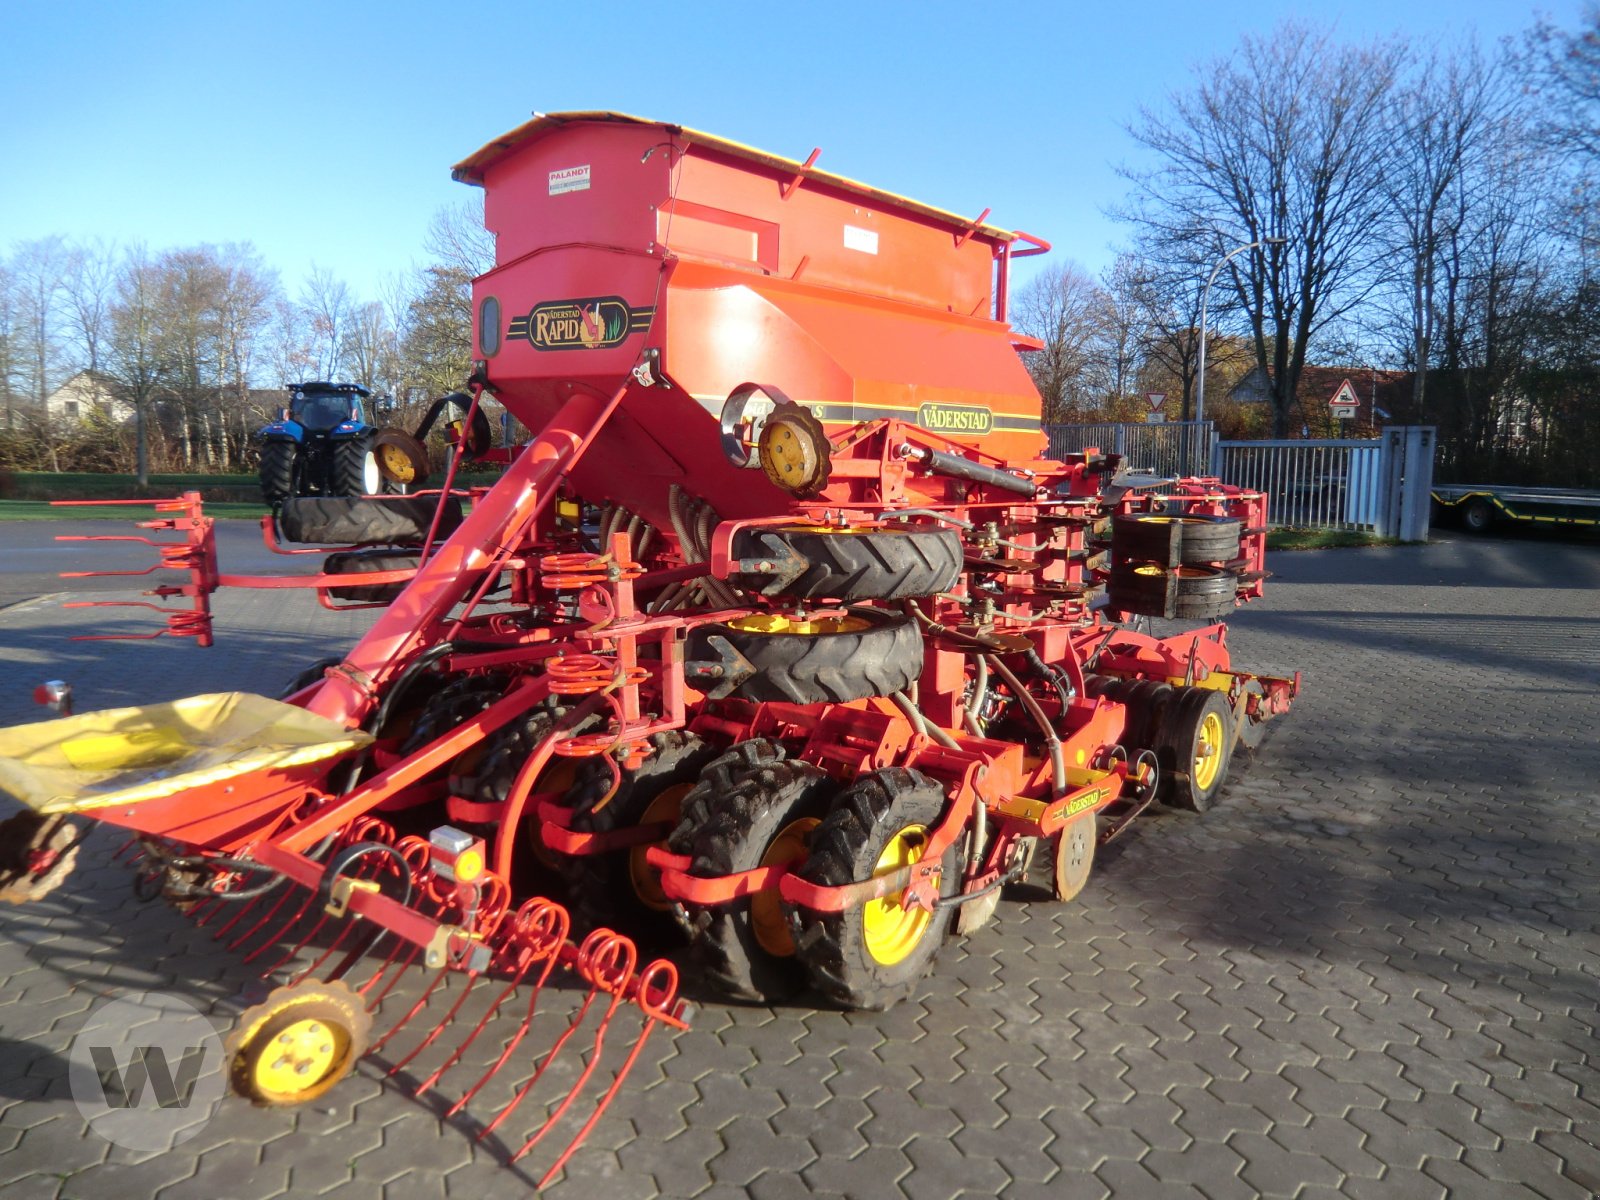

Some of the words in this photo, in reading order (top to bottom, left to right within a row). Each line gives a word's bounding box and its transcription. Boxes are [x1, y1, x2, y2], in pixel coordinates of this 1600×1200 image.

[551, 167, 589, 180] PALANDT
[547, 309, 580, 320] VÄDERSTAD
[923, 406, 989, 430] VÄDERSTAD
